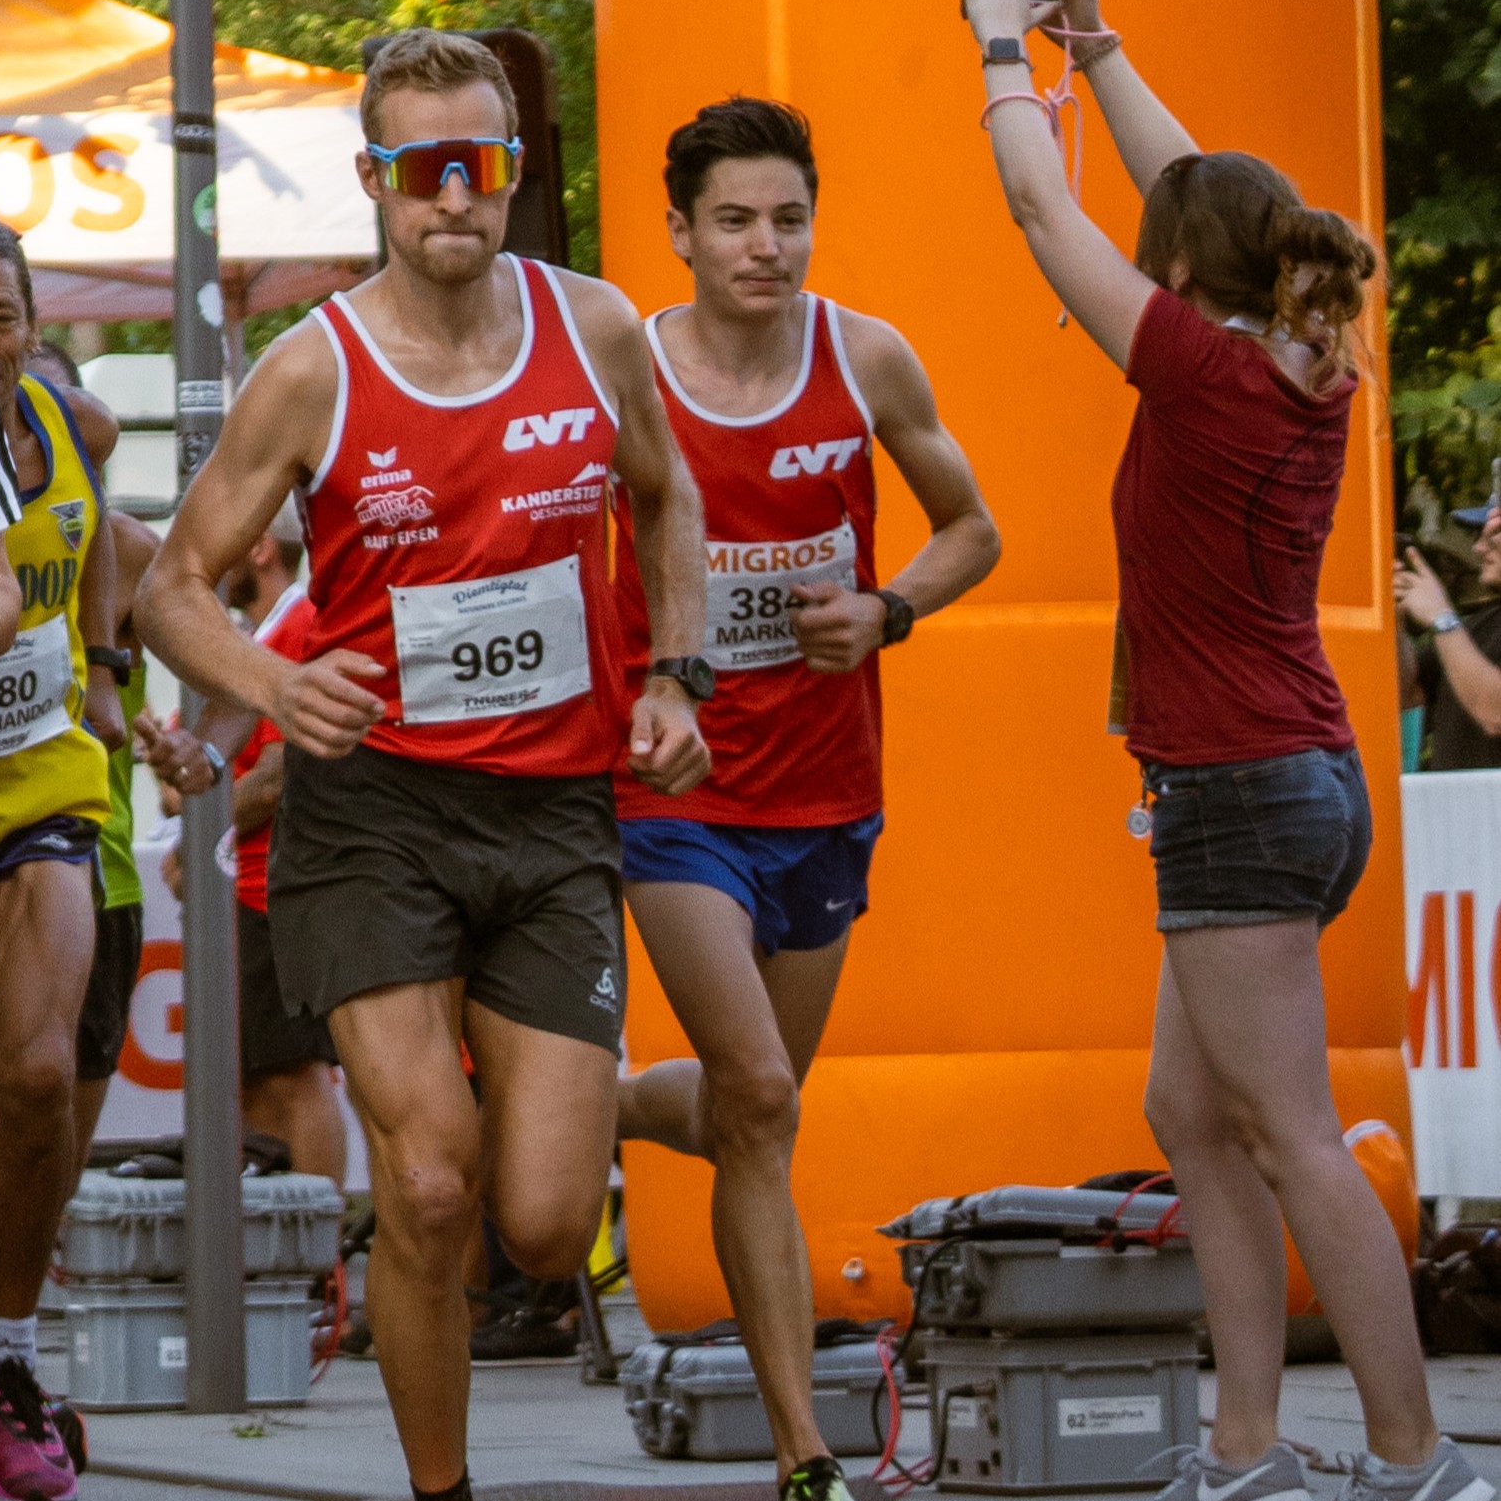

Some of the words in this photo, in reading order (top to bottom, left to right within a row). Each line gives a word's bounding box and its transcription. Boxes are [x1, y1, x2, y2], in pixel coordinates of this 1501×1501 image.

[361, 469, 412, 489] erima
[706, 536, 836, 573] MIGROS
[451, 579, 529, 604] Diemtigtal
[451, 629, 544, 682] 969
